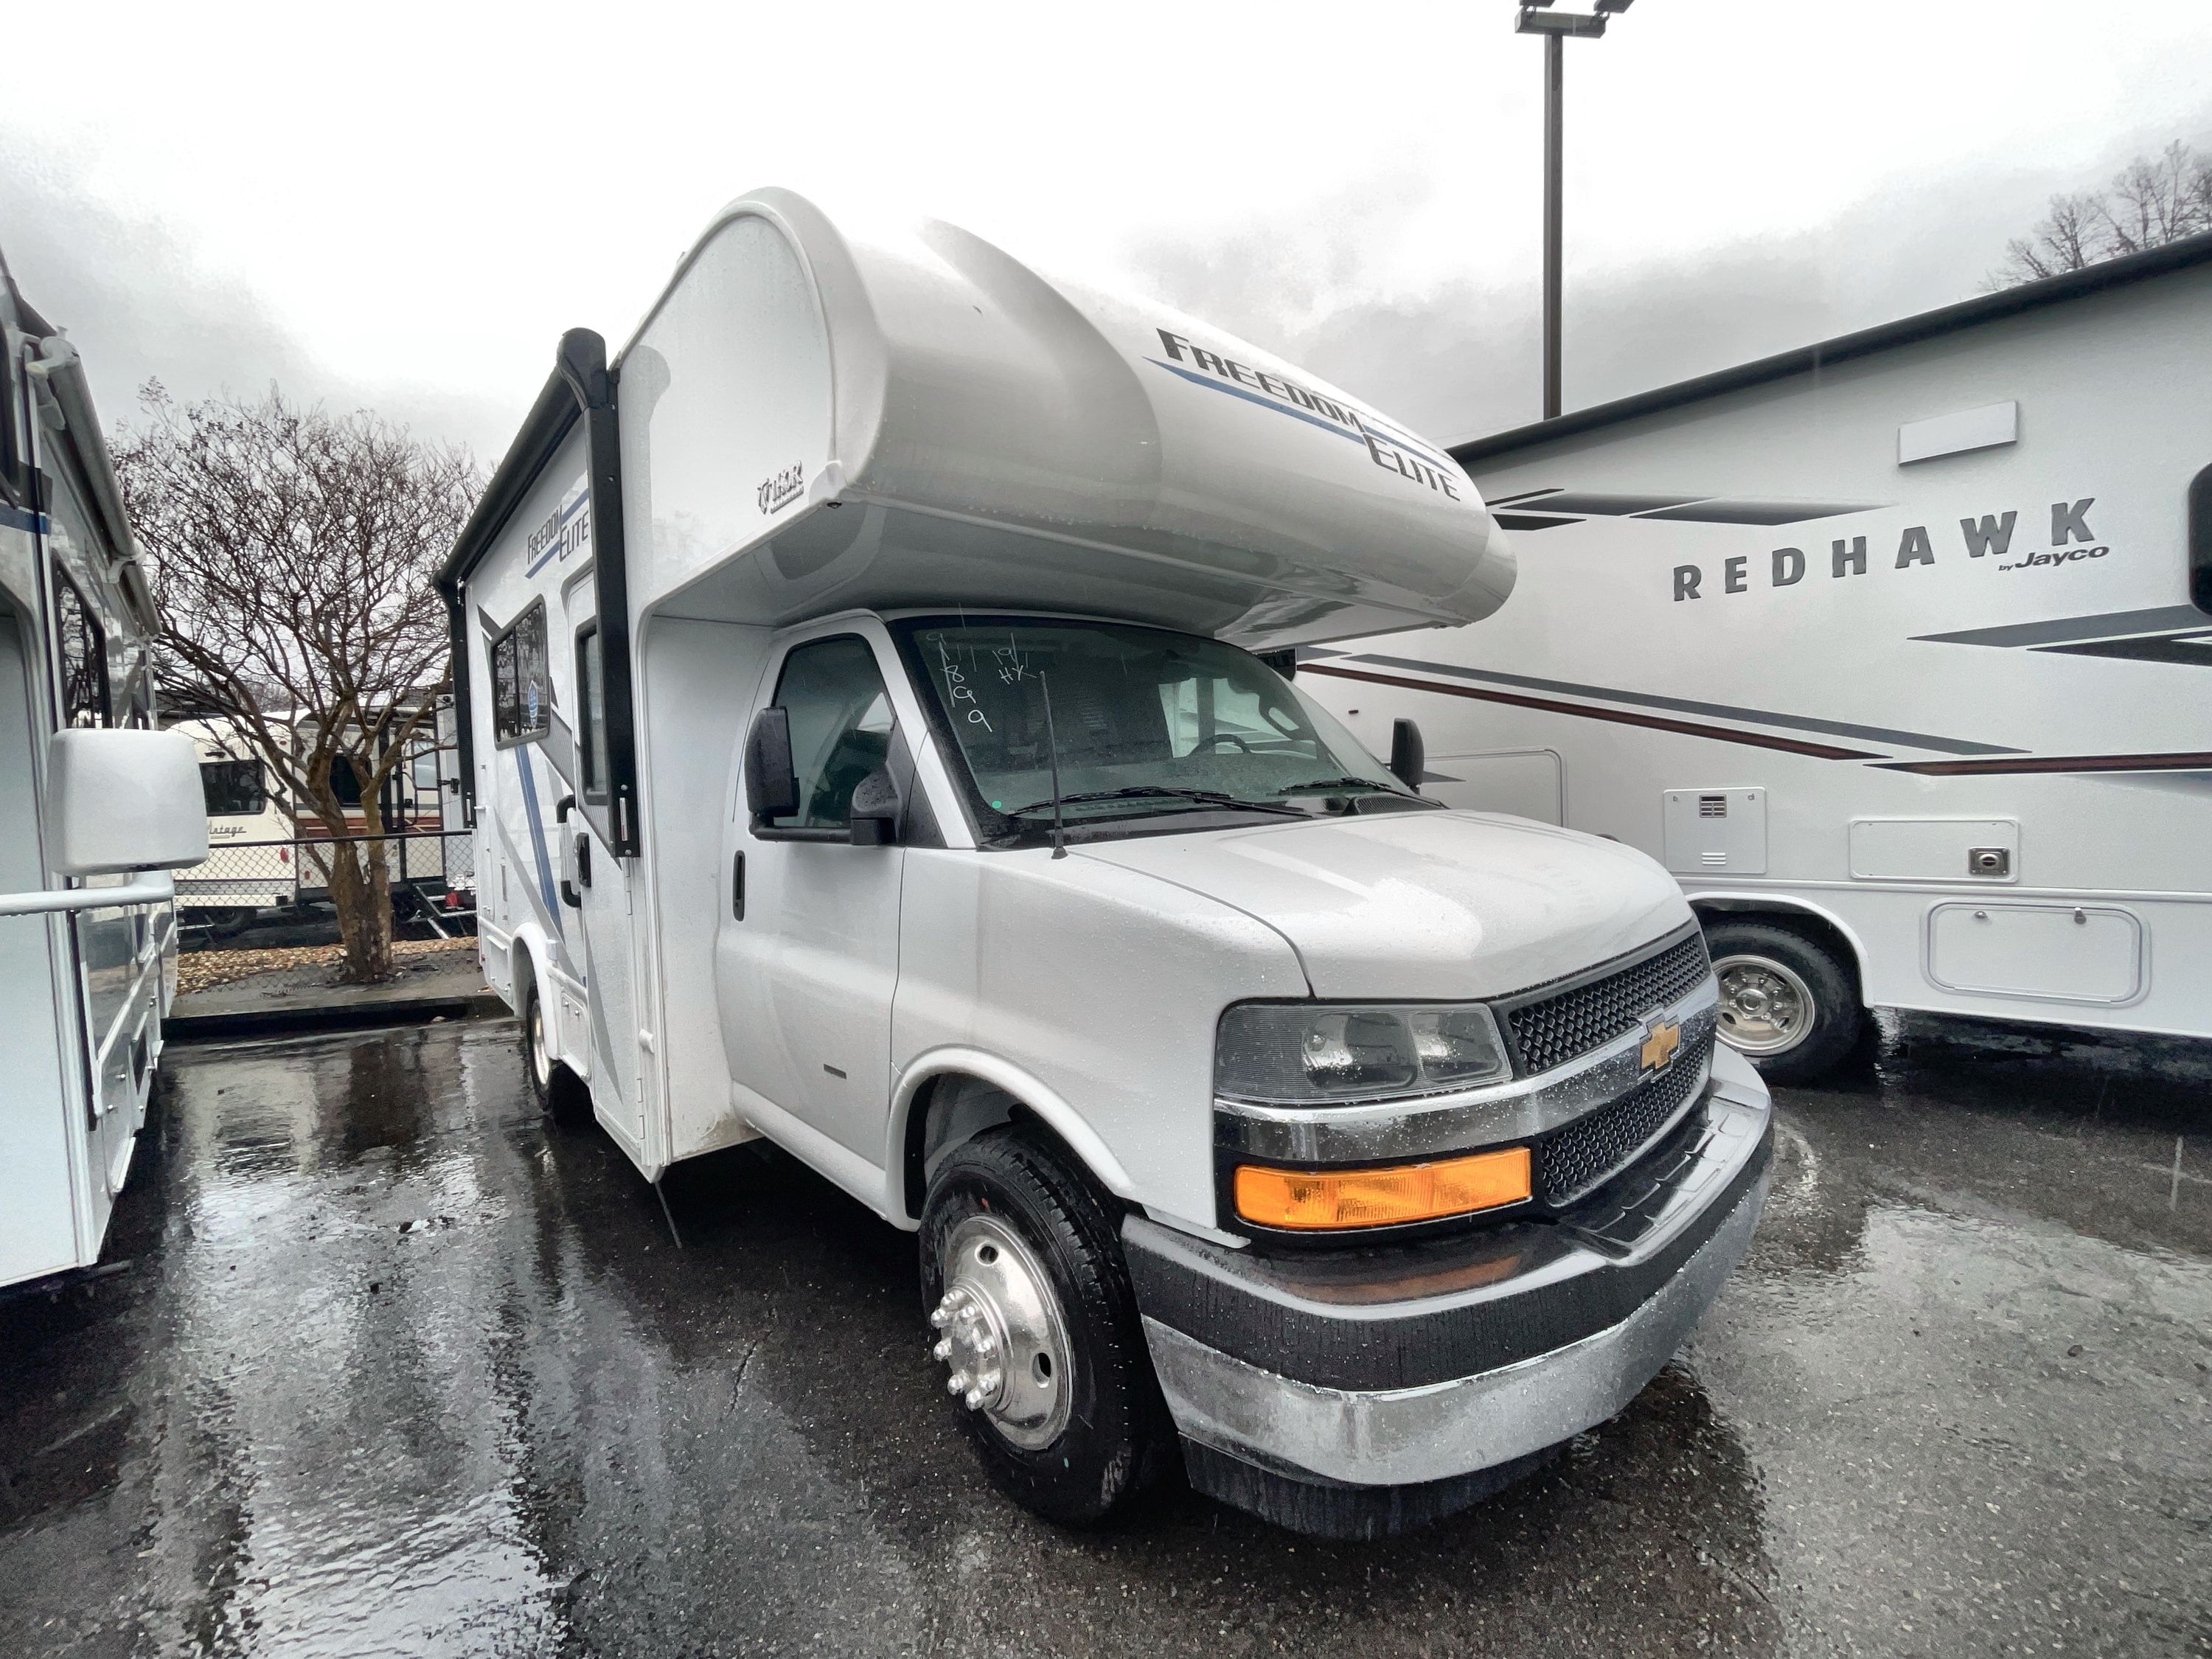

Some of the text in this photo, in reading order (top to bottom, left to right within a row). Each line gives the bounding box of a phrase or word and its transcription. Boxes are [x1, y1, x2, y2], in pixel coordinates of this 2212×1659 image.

[1156, 328, 1365, 434] FREEDOM
[1364, 434, 1461, 502] ELITE
[527, 504, 563, 565] FREEDOM
[559, 510, 589, 563] ELITE
[1674, 498, 2095, 601] REDHAWK
[1998, 546, 2110, 571] by Jayco
